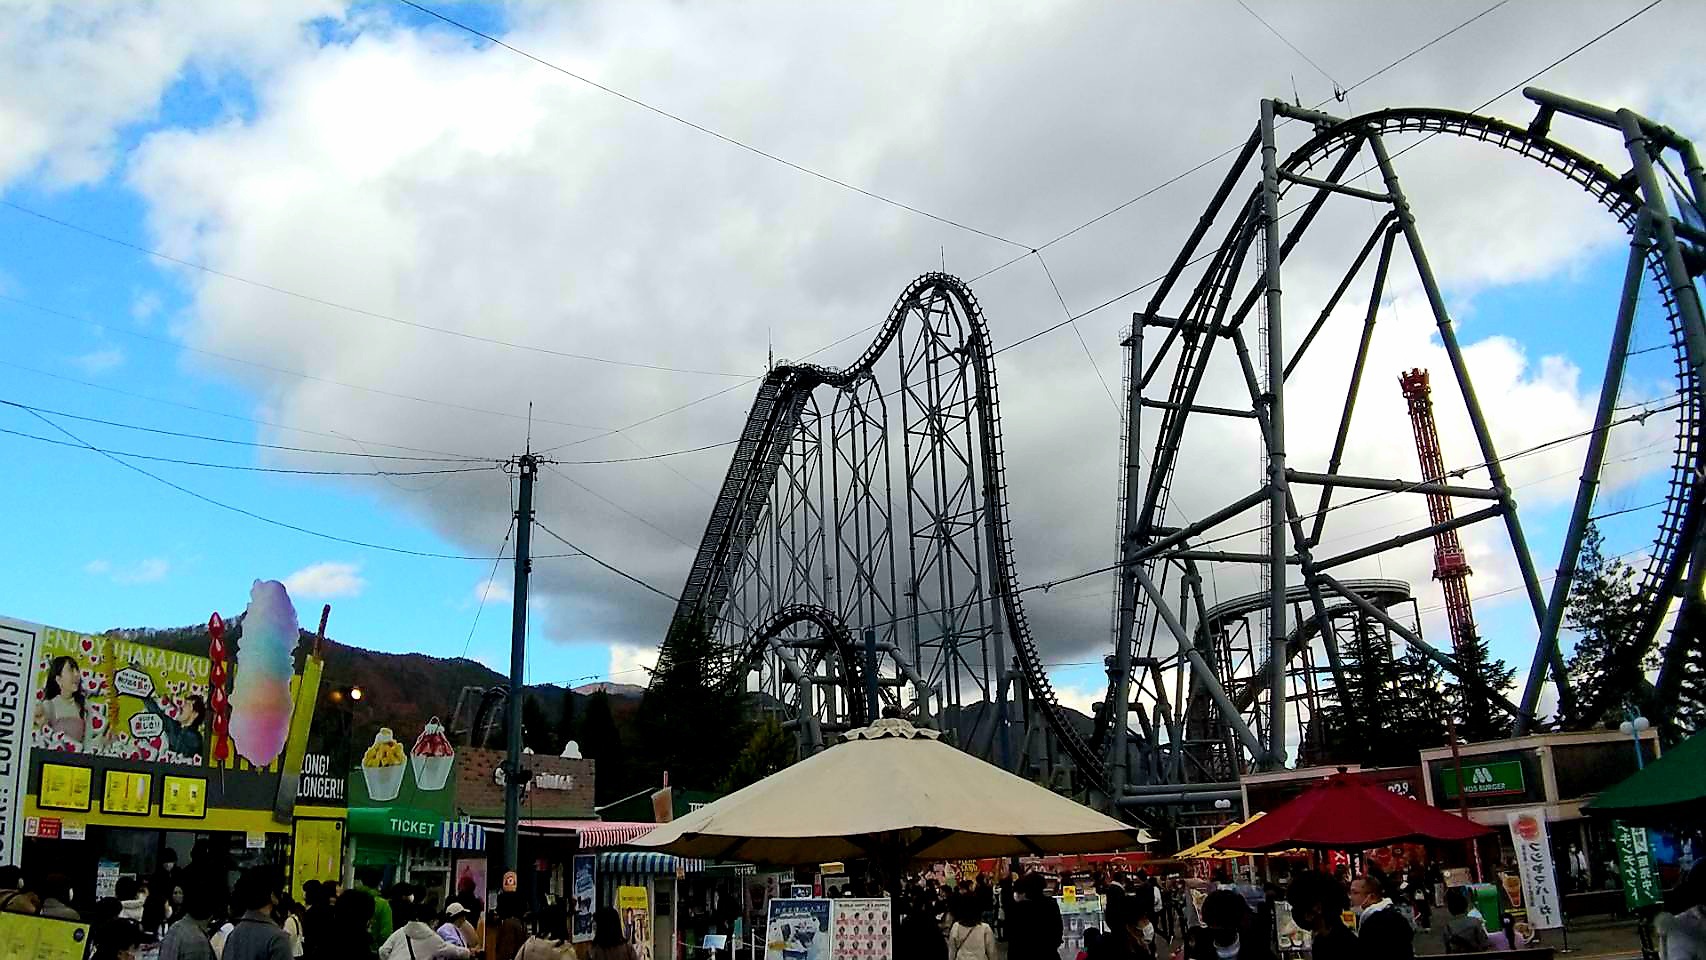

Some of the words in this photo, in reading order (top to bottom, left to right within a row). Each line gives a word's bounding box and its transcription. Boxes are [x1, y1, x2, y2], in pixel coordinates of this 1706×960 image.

[297, 776, 345, 799] LONGER!!
[1479, 782, 1506, 792] BURGER
[390, 818, 435, 836] TICKET
